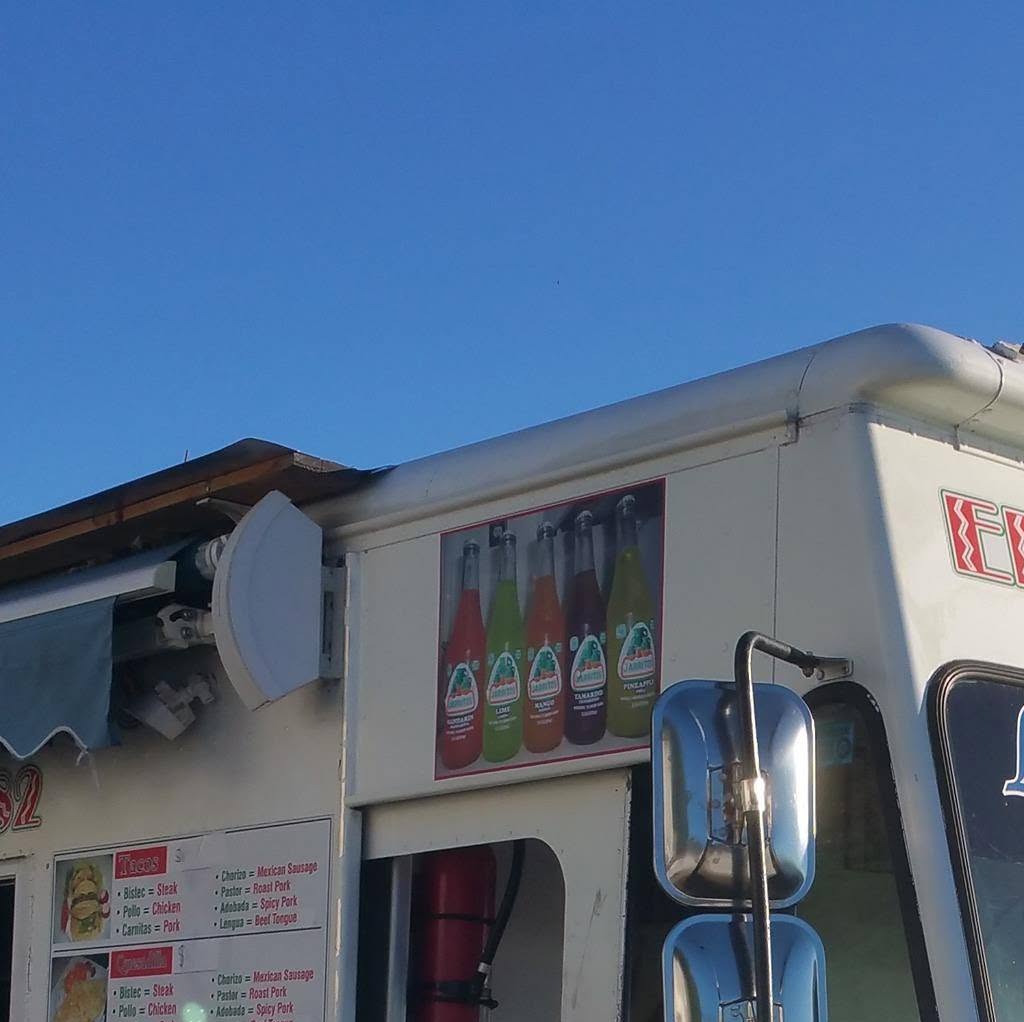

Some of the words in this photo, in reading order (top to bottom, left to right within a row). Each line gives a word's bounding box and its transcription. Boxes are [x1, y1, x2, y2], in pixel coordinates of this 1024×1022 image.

[257, 865, 286, 878] Mexican
[287, 861, 318, 875] Sausage
[156, 882, 178, 896] Steak
[253, 882, 273, 894] Roast
[275, 880, 291, 892] Pork
[152, 901, 181, 915] Chicken
[260, 897, 280, 911] Spicy
[281, 895, 298, 907] Pork
[255, 914, 271, 926] Beef
[272, 912, 297, 926] Tongue
[122, 923, 152, 936] Carnitas
[163, 919, 180, 933] Pork
[253, 970, 282, 983] Mexican
[284, 968, 314, 982] Sausage
[152, 983, 174, 997] Steak
[249, 987, 269, 999] Roast
[271, 985, 287, 998] Pork
[148, 1003, 177, 1017] Chicken
[256, 1003, 275, 1016] Spicy
[277, 1001, 294, 1014] Pork
